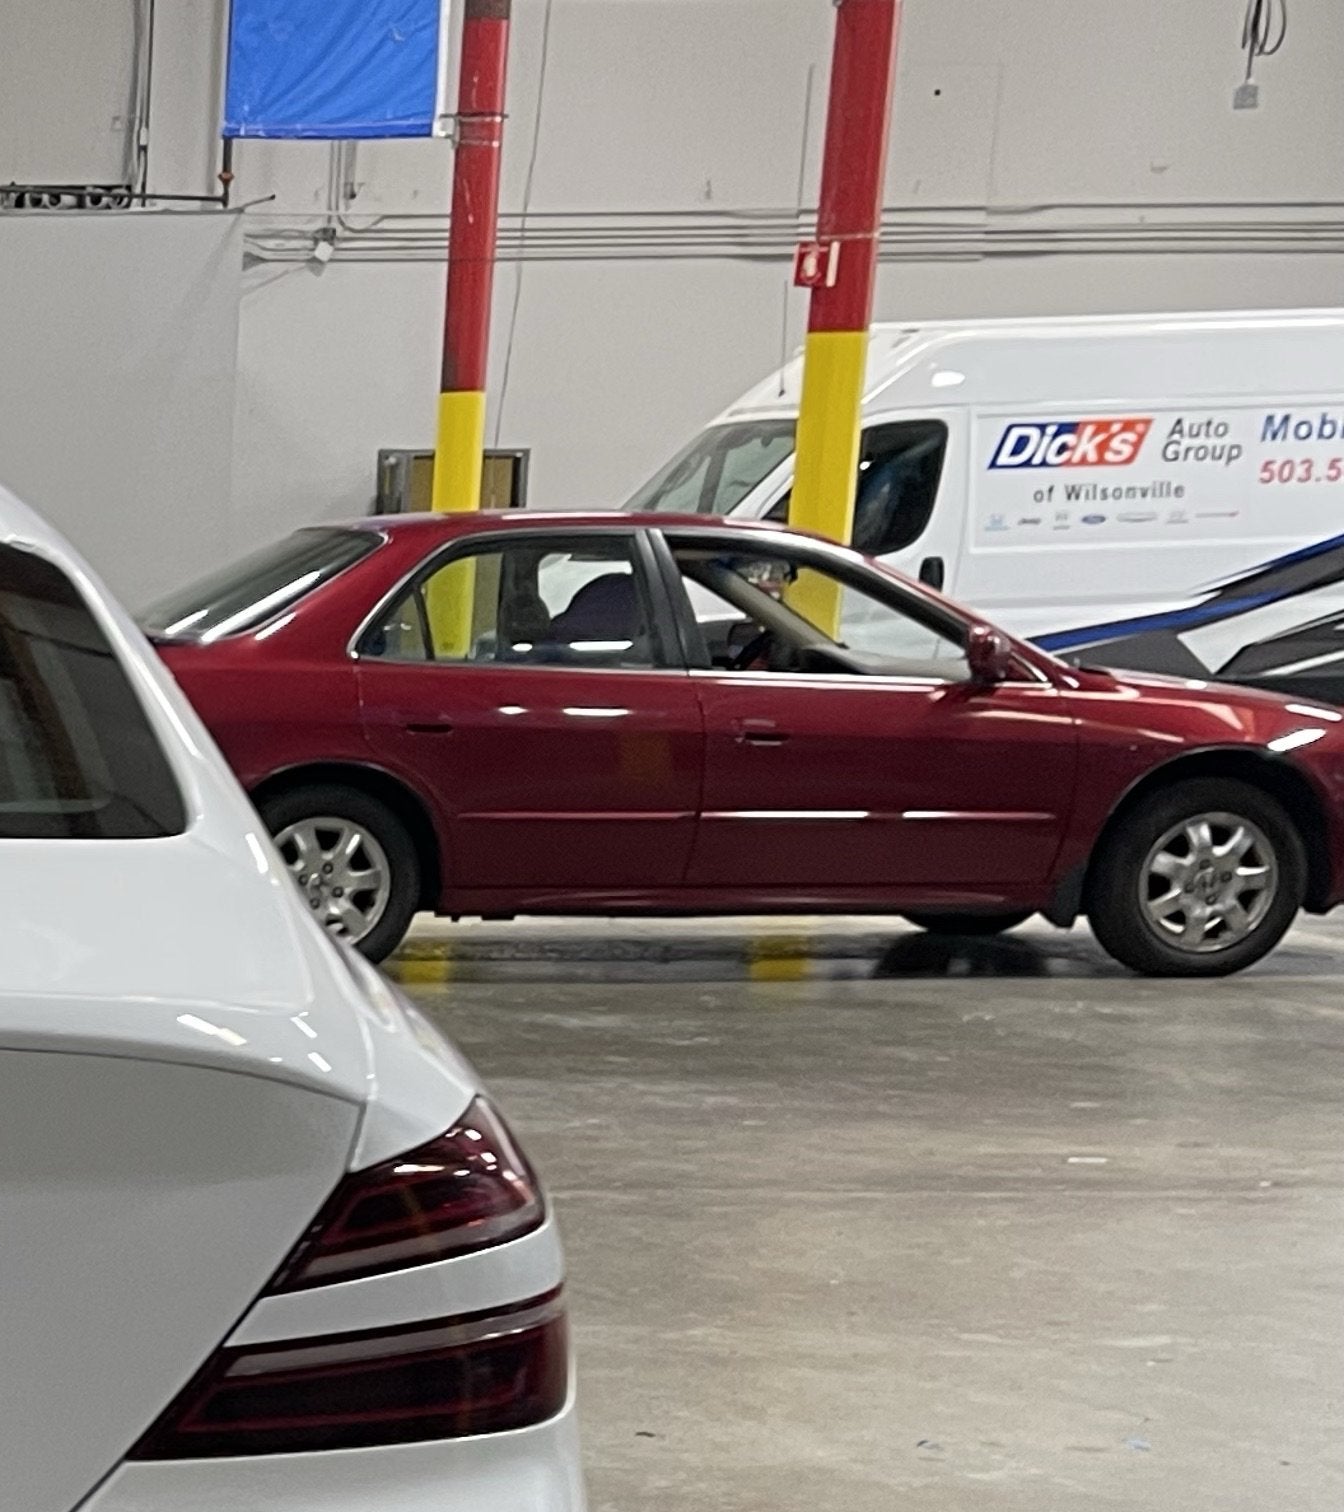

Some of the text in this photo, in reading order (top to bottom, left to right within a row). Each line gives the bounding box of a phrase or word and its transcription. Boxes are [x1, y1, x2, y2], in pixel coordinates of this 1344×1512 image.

[1167, 418, 1229, 439] Auto
[1162, 440, 1243, 465] Group
[1033, 481, 1186, 503] of Wilsonville
